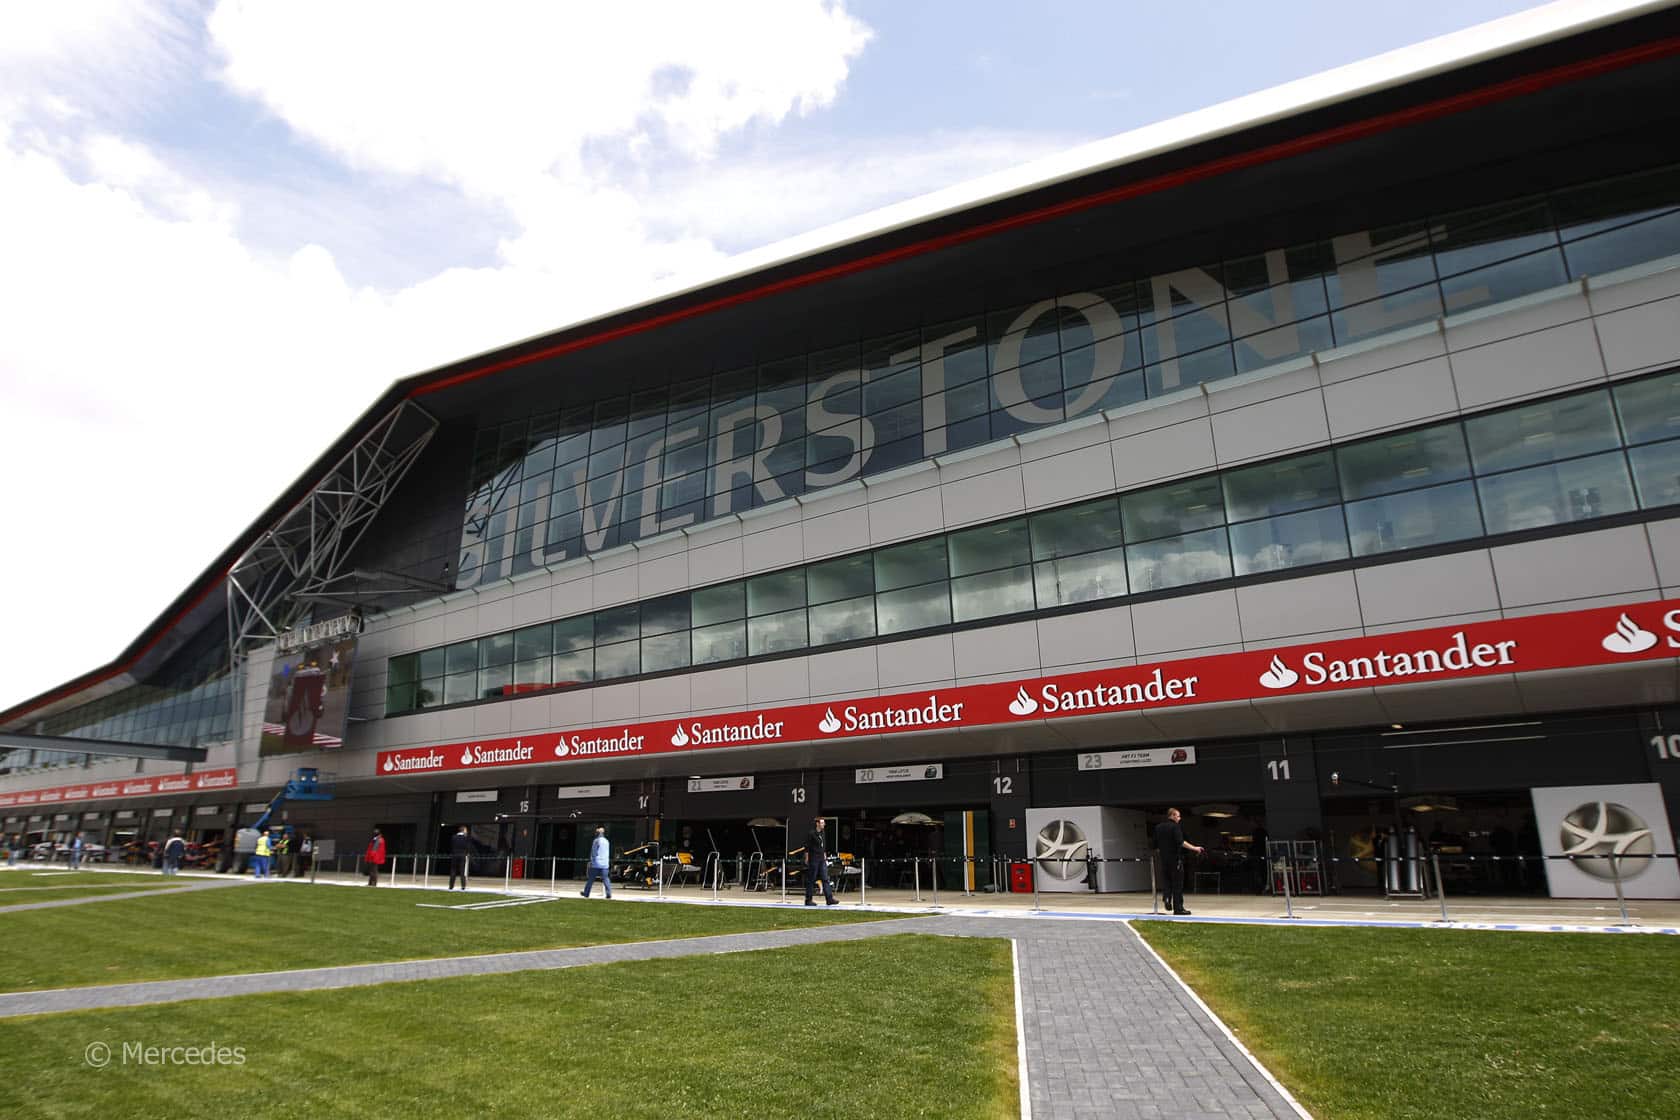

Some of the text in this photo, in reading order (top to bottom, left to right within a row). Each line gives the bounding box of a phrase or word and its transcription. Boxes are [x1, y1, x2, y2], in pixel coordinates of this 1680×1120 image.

[455, 224, 1490, 590] SILVERSTONE
[1303, 632, 1516, 685] Santander
[1041, 668, 1198, 713] Santander
[844, 695, 964, 732] Santander
[691, 714, 784, 745] Santander
[474, 740, 534, 764] Santander
[571, 729, 645, 755] Santander
[393, 749, 445, 770] Santander
[1084, 754, 1102, 769] 23
[1267, 759, 1290, 780] 11
[860, 769, 874, 782] 20
[993, 776, 1012, 794] 12
[519, 800, 529, 813] 15
[791, 788, 805, 803] 13
